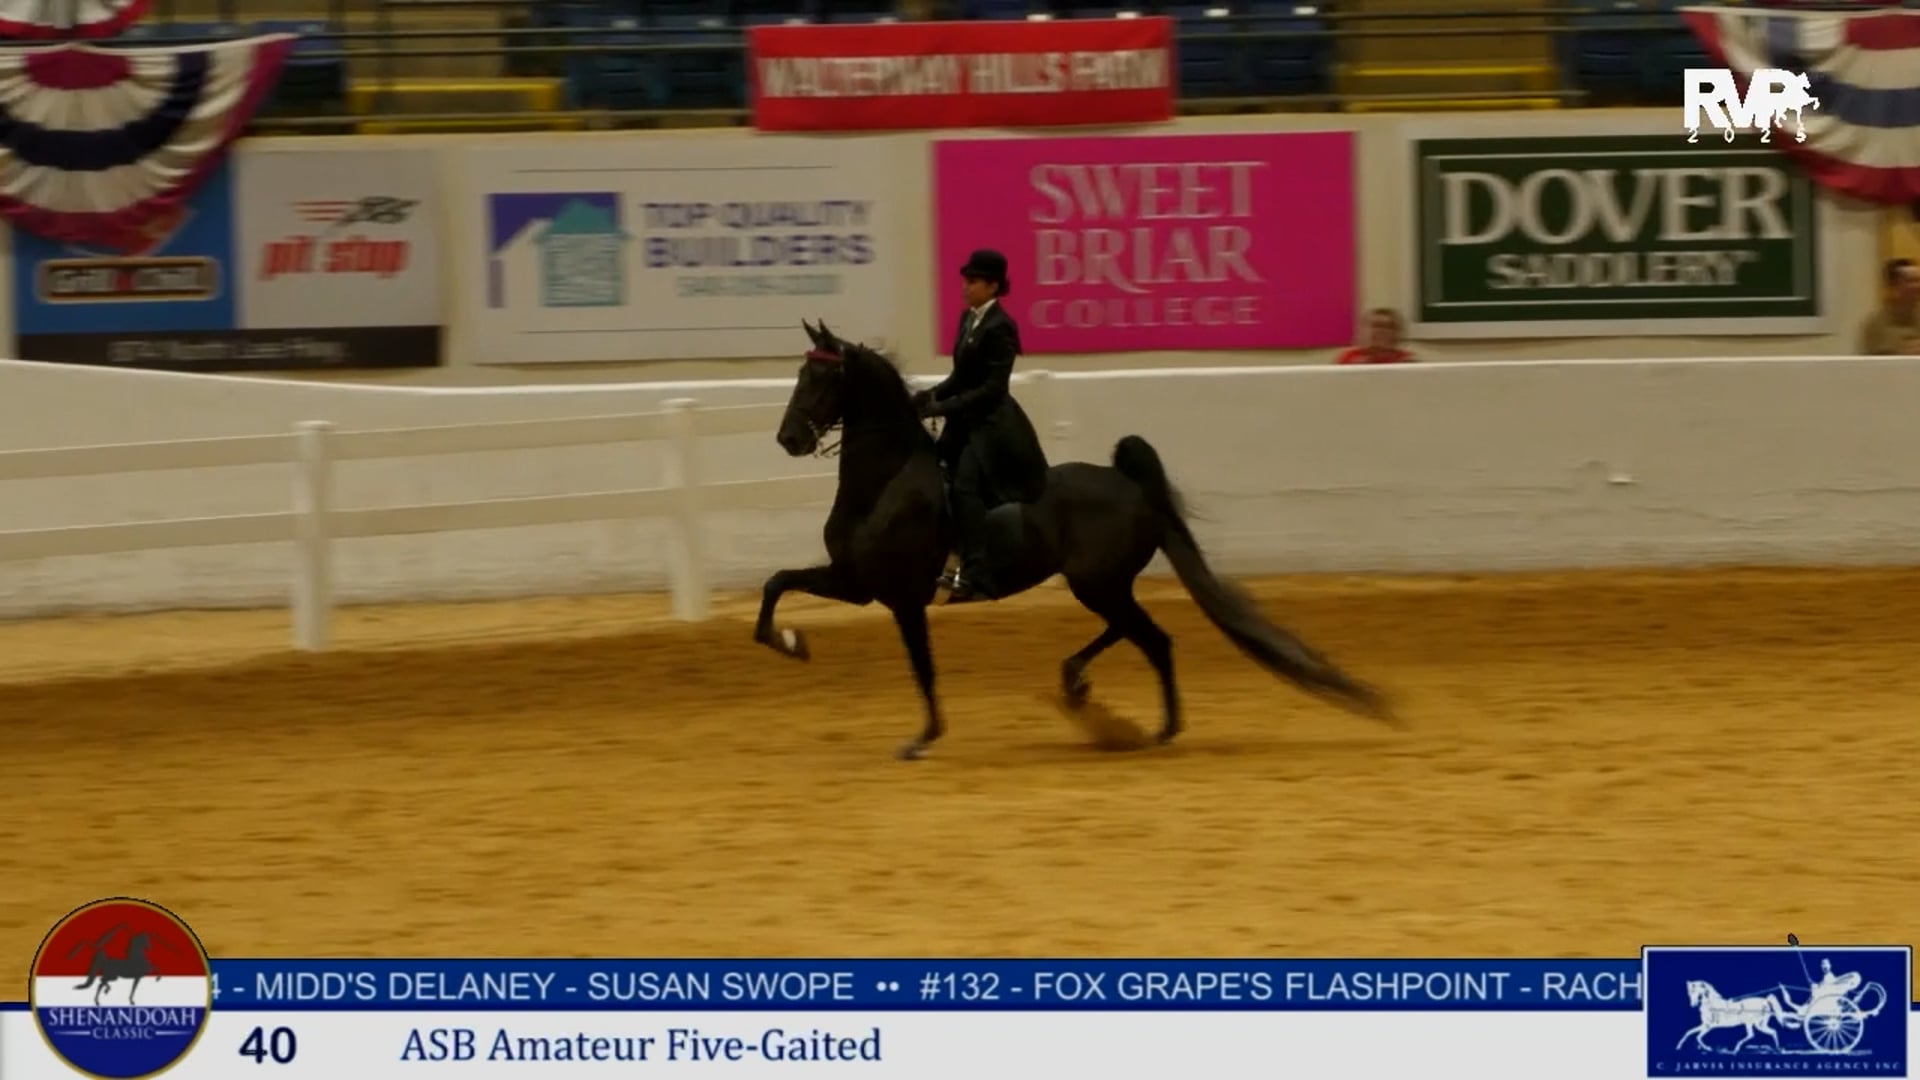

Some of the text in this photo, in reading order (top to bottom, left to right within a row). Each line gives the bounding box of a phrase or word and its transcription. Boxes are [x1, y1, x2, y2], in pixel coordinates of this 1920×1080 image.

[967, 52, 1065, 93] HILLS
[1069, 48, 1168, 91] FARM
[643, 200, 875, 229] TOP QUALITY
[1028, 161, 1268, 223] SWEET
[1440, 166, 1794, 245] DOVER
[259, 234, 410, 281] pit stop
[644, 234, 875, 268] BUILDERS
[1034, 226, 1268, 294] BRIAR
[1486, 251, 1742, 289] SADDLERY
[1031, 296, 1262, 329] COLLEGE
